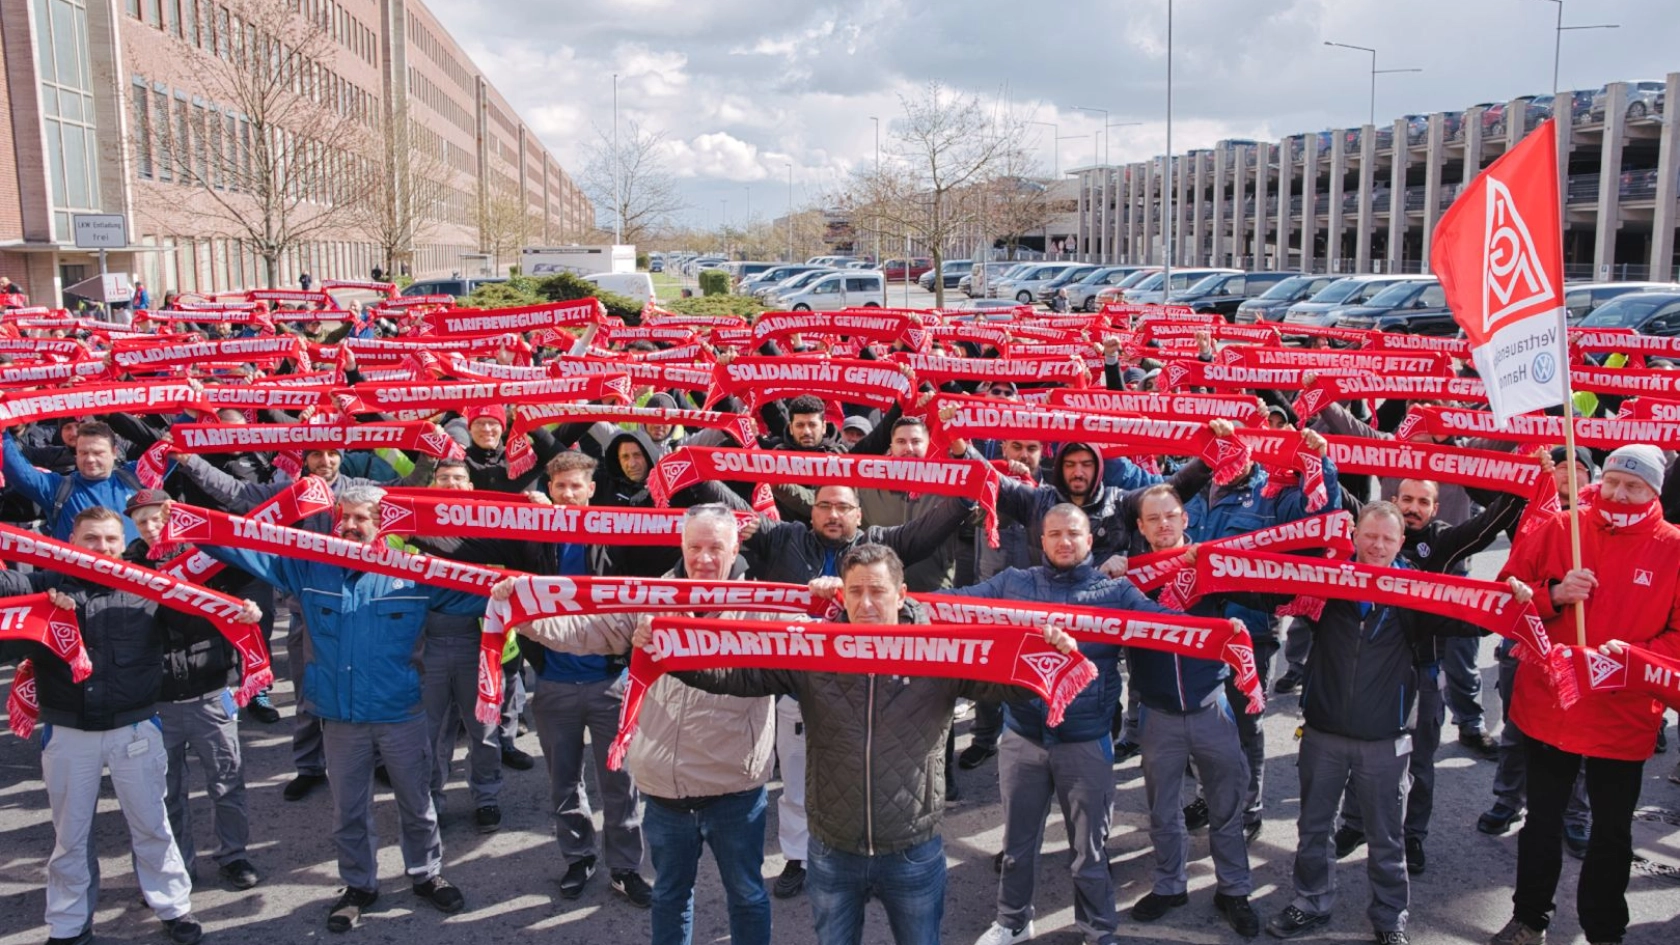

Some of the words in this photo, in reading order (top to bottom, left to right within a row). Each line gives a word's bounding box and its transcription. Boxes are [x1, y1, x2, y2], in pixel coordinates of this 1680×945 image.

[92, 221, 121, 230] Entladung
[445, 311, 552, 332] TARIFBEWEGUNG
[553, 305, 592, 324] JETZT!
[754, 312, 832, 338] SOLIDARITÄT
[833, 314, 900, 332] GEWINNT!
[470, 334, 518, 350] JETZT!
[1151, 324, 1217, 335] SOLIDARITÄT
[1219, 326, 1271, 341] GEWINNT!
[1384, 334, 1466, 353] SOLIDARITÄT
[35, 341, 77, 354] JETZT!
[115, 342, 219, 367] SOLIDARITÄT
[220, 337, 295, 355] GEWINNT!
[450, 357, 551, 381] TARIFBEWEGU
[557, 359, 662, 380] SOLIDARITÄT
[730, 361, 842, 383] SOLIDARITÄT
[907, 352, 1038, 378] TARIFBEWEGUNG
[1036, 360, 1080, 380] JETZT
[1203, 363, 1300, 384] SOLIDARITÄT
[1256, 350, 1383, 371] TARIFBEWEGUNG
[1382, 355, 1435, 374] JETZT!
[266, 389, 321, 408] JETZT!
[376, 382, 497, 404] SOLIDARITÄT
[499, 376, 589, 398] GEWINNT!
[1335, 376, 1446, 395] SOLIDARITÄT
[516, 402, 663, 422] TARIFBEWEGUNG
[663, 407, 722, 423] JETZT!
[1062, 392, 1169, 414] SOLIDARITÄT
[1172, 395, 1257, 421] GEWINNT!
[181, 421, 345, 448] TARIFBEWEGUNG
[343, 426, 405, 446] JETZT!
[1082, 412, 1201, 442] GEWINNT!
[710, 449, 855, 479] SOLIDARITÄT
[857, 457, 972, 487] GEWINNT!
[1428, 451, 1542, 487] GEWINNT!
[435, 503, 579, 533] SOLIDARITÄT
[583, 511, 685, 534] GEWINNT
[228, 514, 427, 575] TARIFBEWEGUNG
[424, 556, 503, 588] JETZT!
[591, 579, 683, 606] FÜR
[1209, 552, 1373, 590] SOLIDARITÄT
[1375, 571, 1513, 616] GEWINNT!
[162, 581, 246, 624] JETZT!
[1122, 618, 1214, 650] JETZT!
[832, 633, 995, 665] GEWINNT!
